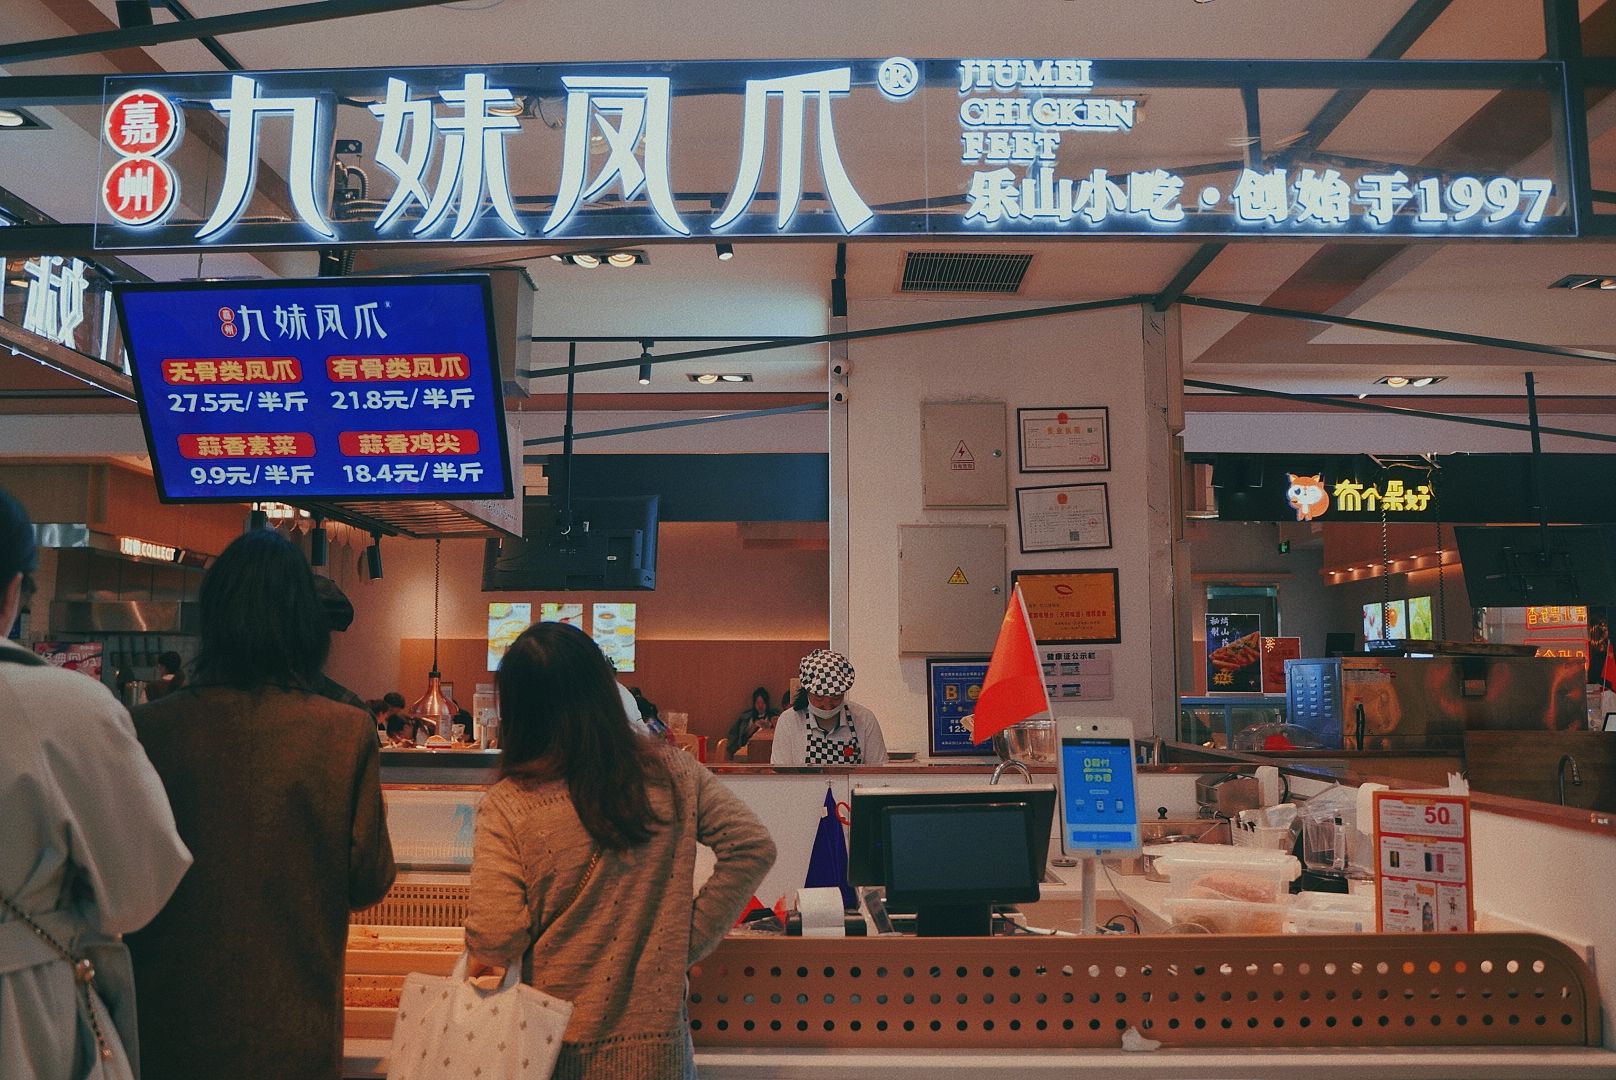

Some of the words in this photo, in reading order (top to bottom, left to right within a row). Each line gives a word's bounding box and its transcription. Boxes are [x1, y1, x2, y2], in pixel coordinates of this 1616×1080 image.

[960, 60, 1093, 93] JIUMEI
[960, 98, 1136, 128] CHICKEN
[116, 99, 160, 213] 嘉州
[195, 68, 873, 238] 九妹凤爪
[962, 132, 1060, 159] FEET
[237, 302, 388, 342] 九妹凤爪
[168, 360, 297, 382] 无骨类凤爪
[332, 357, 465, 379] 有骨类凤爪
[196, 435, 298, 456] 蒜香素菜
[358, 432, 461, 454] 蒜香鸡尖
[1047, 652, 1096, 660] 健康证公示栏
[1424, 806, 1450, 824] 50
